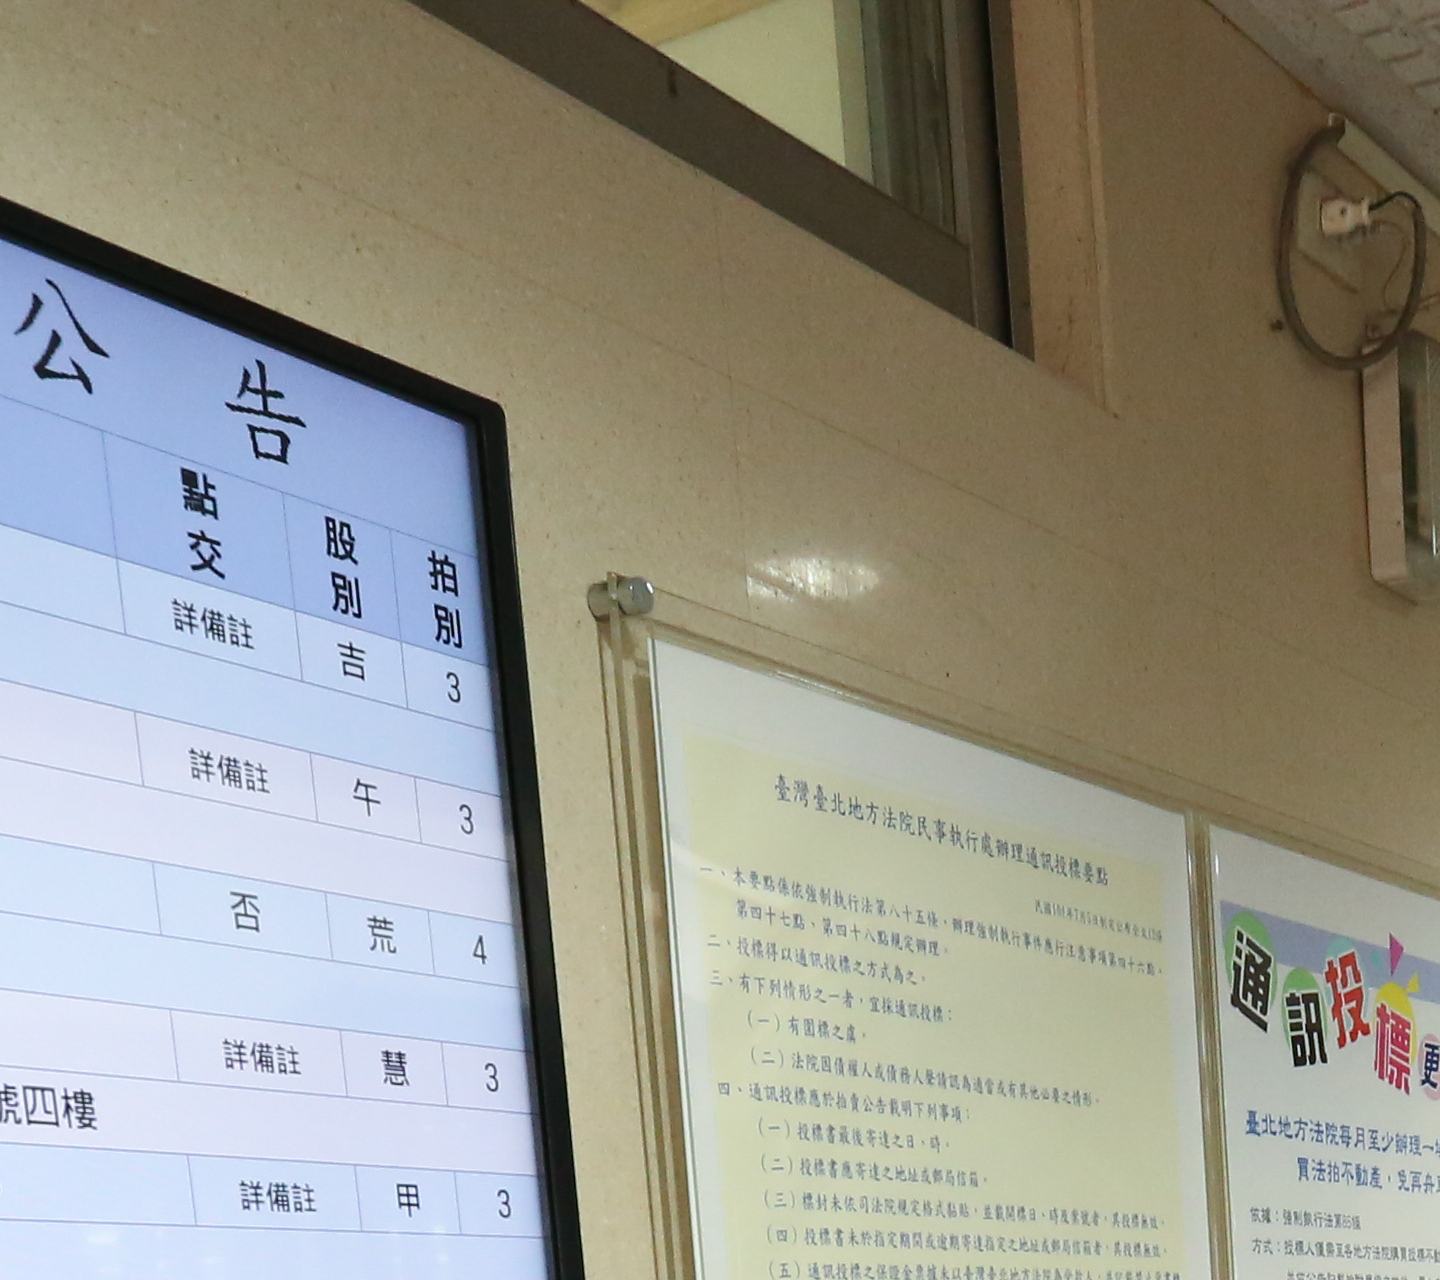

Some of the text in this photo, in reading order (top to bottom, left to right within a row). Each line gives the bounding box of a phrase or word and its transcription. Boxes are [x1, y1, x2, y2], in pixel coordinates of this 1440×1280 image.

[179, 466, 225, 579] 點交
[323, 515, 363, 619] 股別
[428, 549, 463, 649] 拍別
[172, 599, 255, 651] 詳備註
[337, 640, 367, 682] 吉
[446, 671, 461, 704] 3
[188, 748, 271, 795] 詳備註
[353, 778, 381, 817] 午
[459, 804, 475, 835] 3
[772, 771, 1109, 889] 臺灣臺北地方法院民事執行處辦理通訊投標要點
[229, 890, 261, 934] 否
[366, 914, 397, 955] 荒
[472, 934, 488, 967] 4
[221, 1038, 302, 1077] 詳備註
[380, 1048, 411, 1087] 慧
[484, 1061, 500, 1093] 3
[239, 1180, 317, 1214] 詳備註
[396, 1182, 421, 1219] 甲
[497, 1188, 512, 1219] 3
